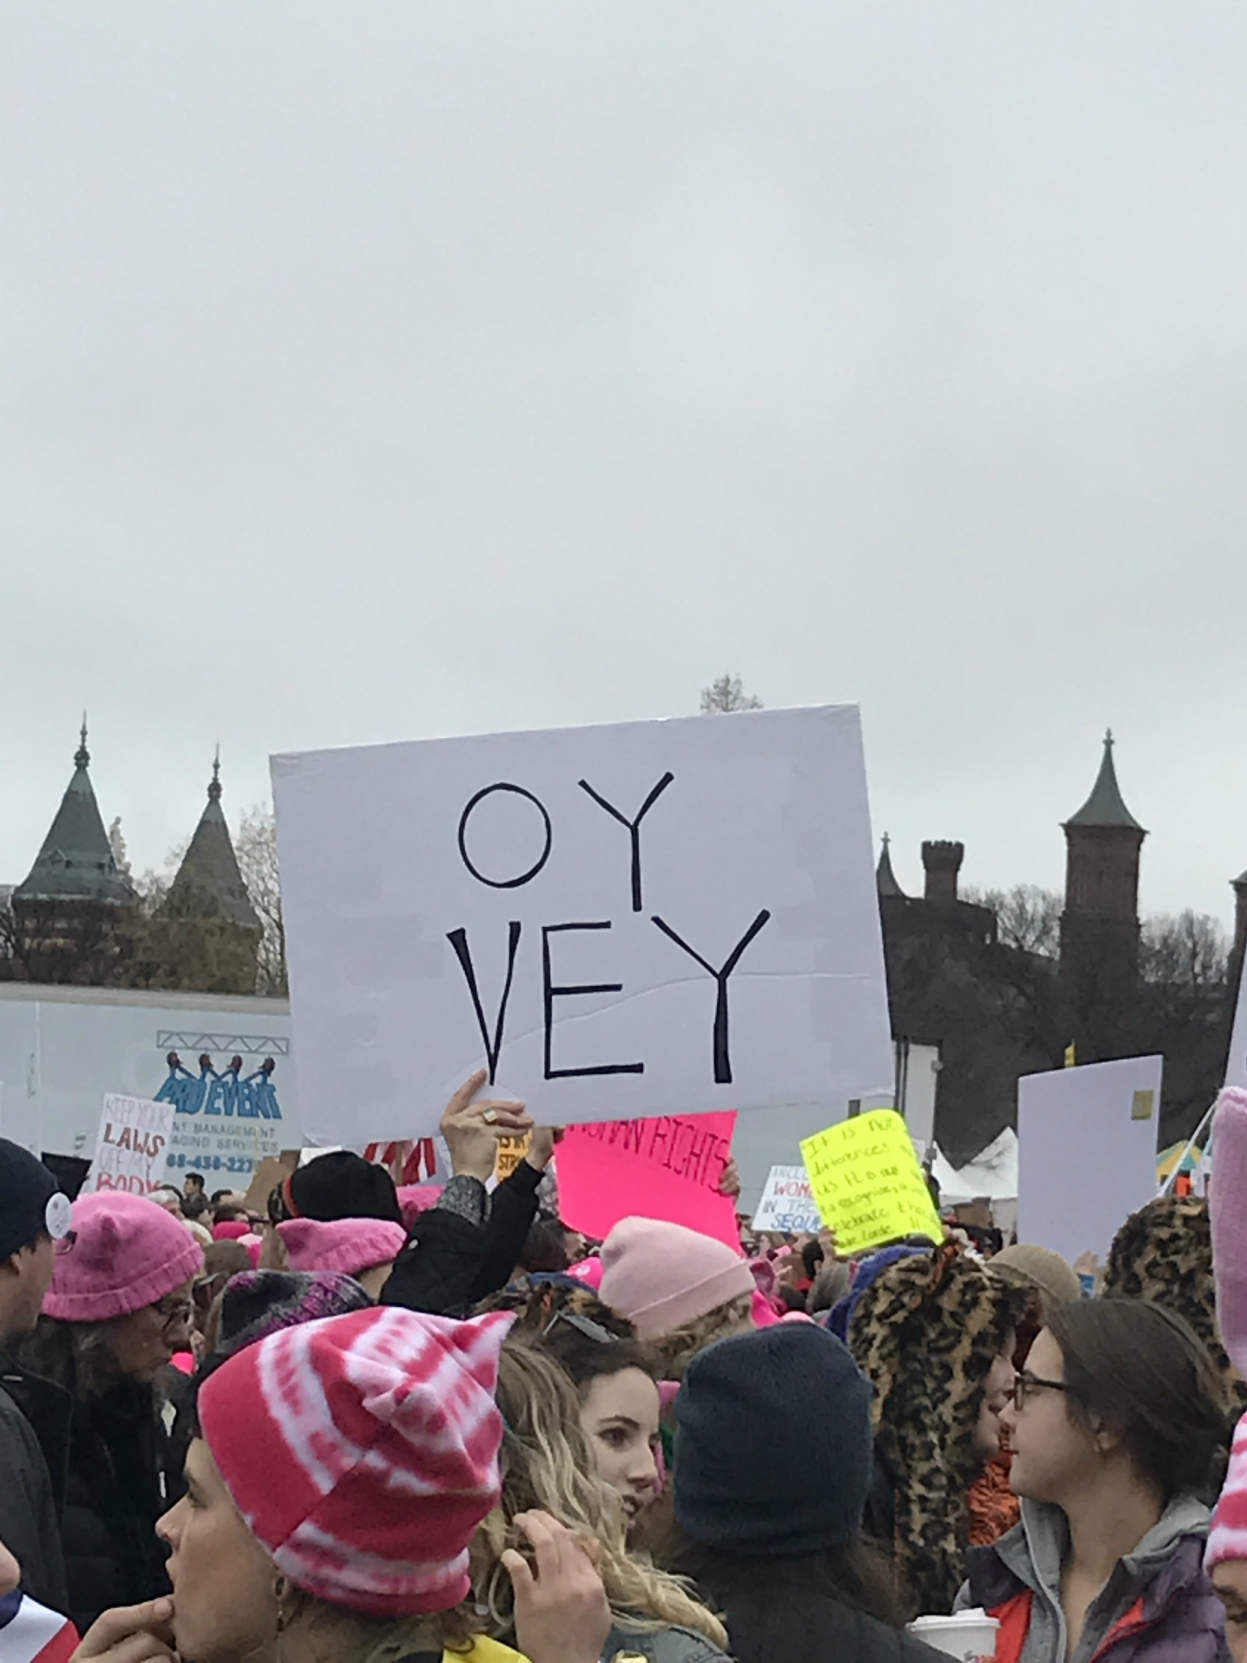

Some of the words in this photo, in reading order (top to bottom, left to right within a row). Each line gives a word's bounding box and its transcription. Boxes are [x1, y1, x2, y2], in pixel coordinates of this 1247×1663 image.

[458, 771, 675, 912] OY
[445, 908, 771, 1086] VEY
[152, 1076, 207, 1115] PRO
[204, 1079, 282, 1120] EVENT
[103, 1123, 165, 1157] LAWS
[648, 1115, 734, 1198] RIGHTS
[96, 1171, 161, 1195] BODY
[773, 1181, 813, 1198] WOM
[771, 1212, 821, 1232] SEQU
